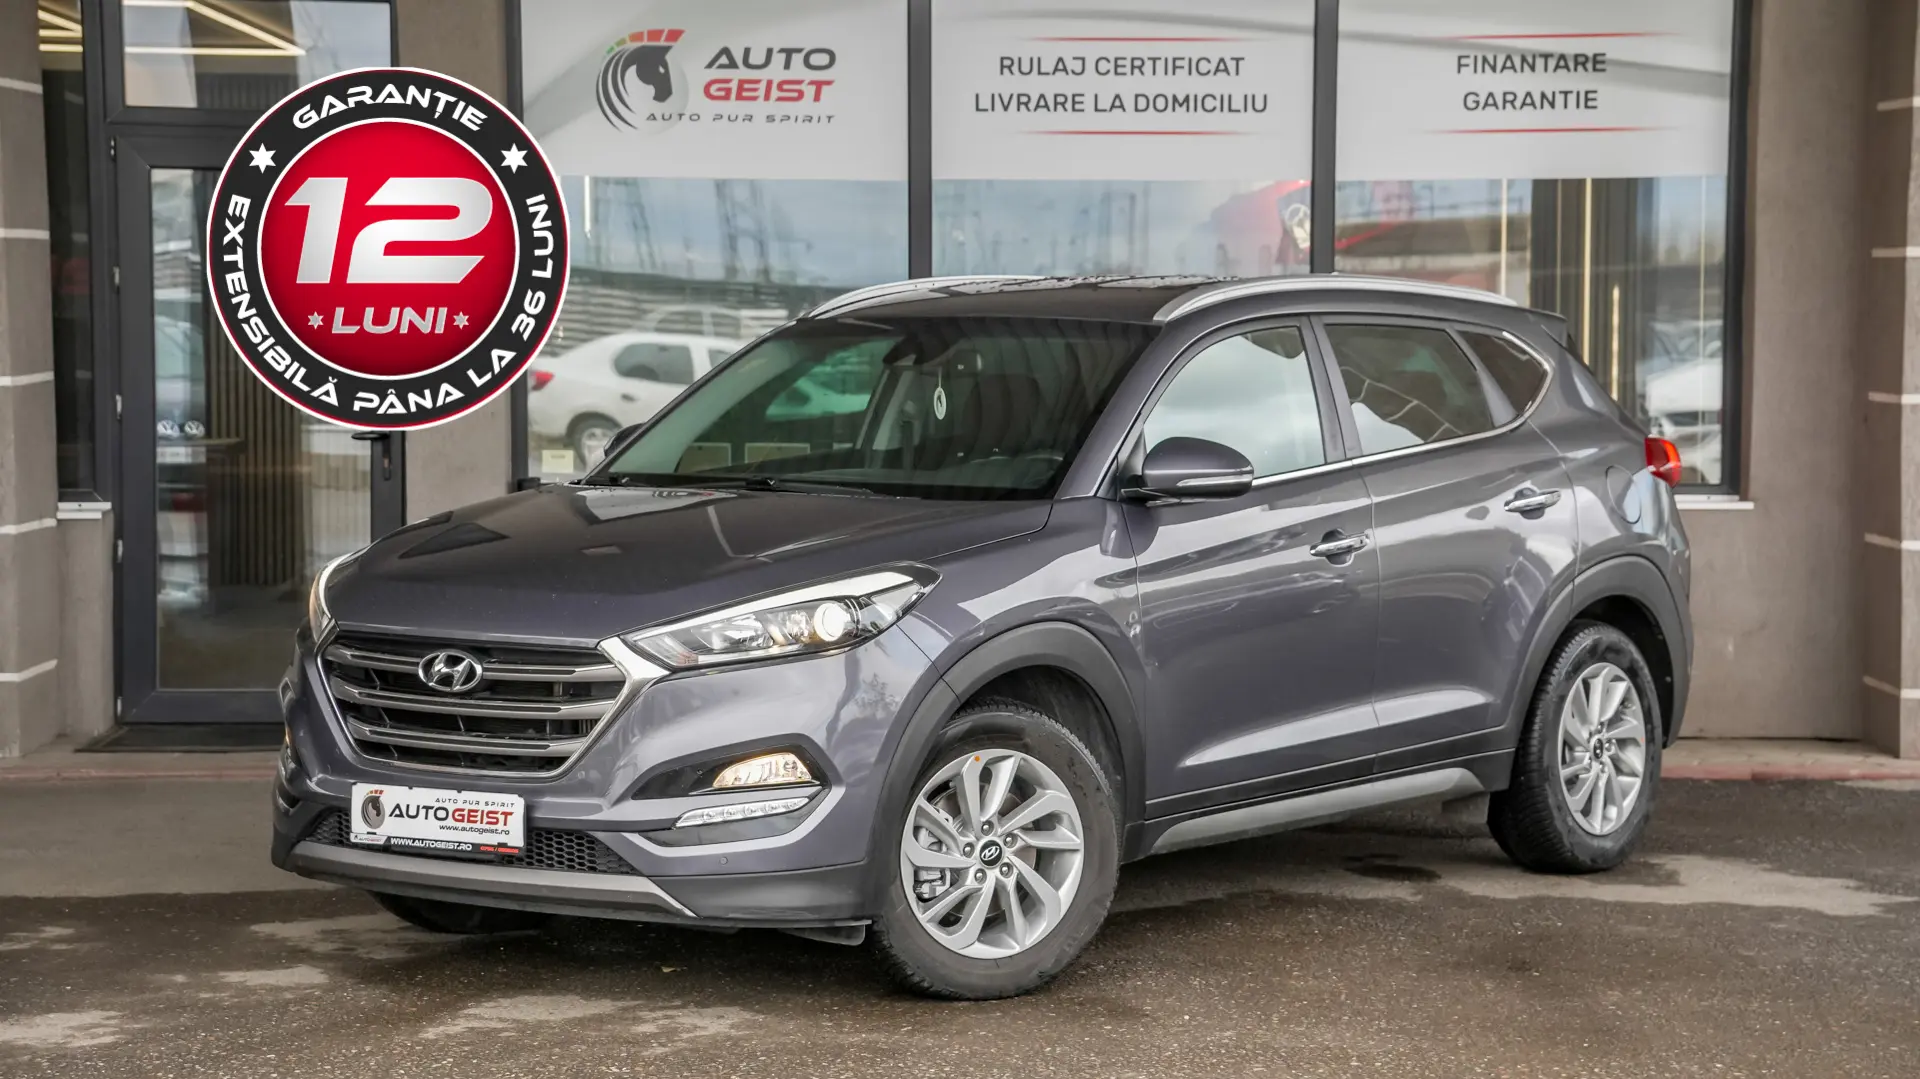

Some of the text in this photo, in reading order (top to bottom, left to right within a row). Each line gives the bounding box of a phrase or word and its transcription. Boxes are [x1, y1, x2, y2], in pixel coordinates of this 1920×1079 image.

[703, 46, 837, 70] AUTO
[999, 56, 1245, 76] RULAJ CERTIFICAT
[1457, 52, 1607, 75] FINANTARE
[703, 78, 835, 103] GEIST
[1463, 90, 1598, 111] GARANTIE
[975, 93, 1268, 113] LIVRARE LA DOMICILIU
[645, 112, 835, 124] AUTO PUR SPIRIT
[388, 803, 514, 827] AUTOGEIST
[439, 824, 510, 836] www.autogeist.ro
[390, 837, 473, 851] WWW.AUTOGEIST.RO
